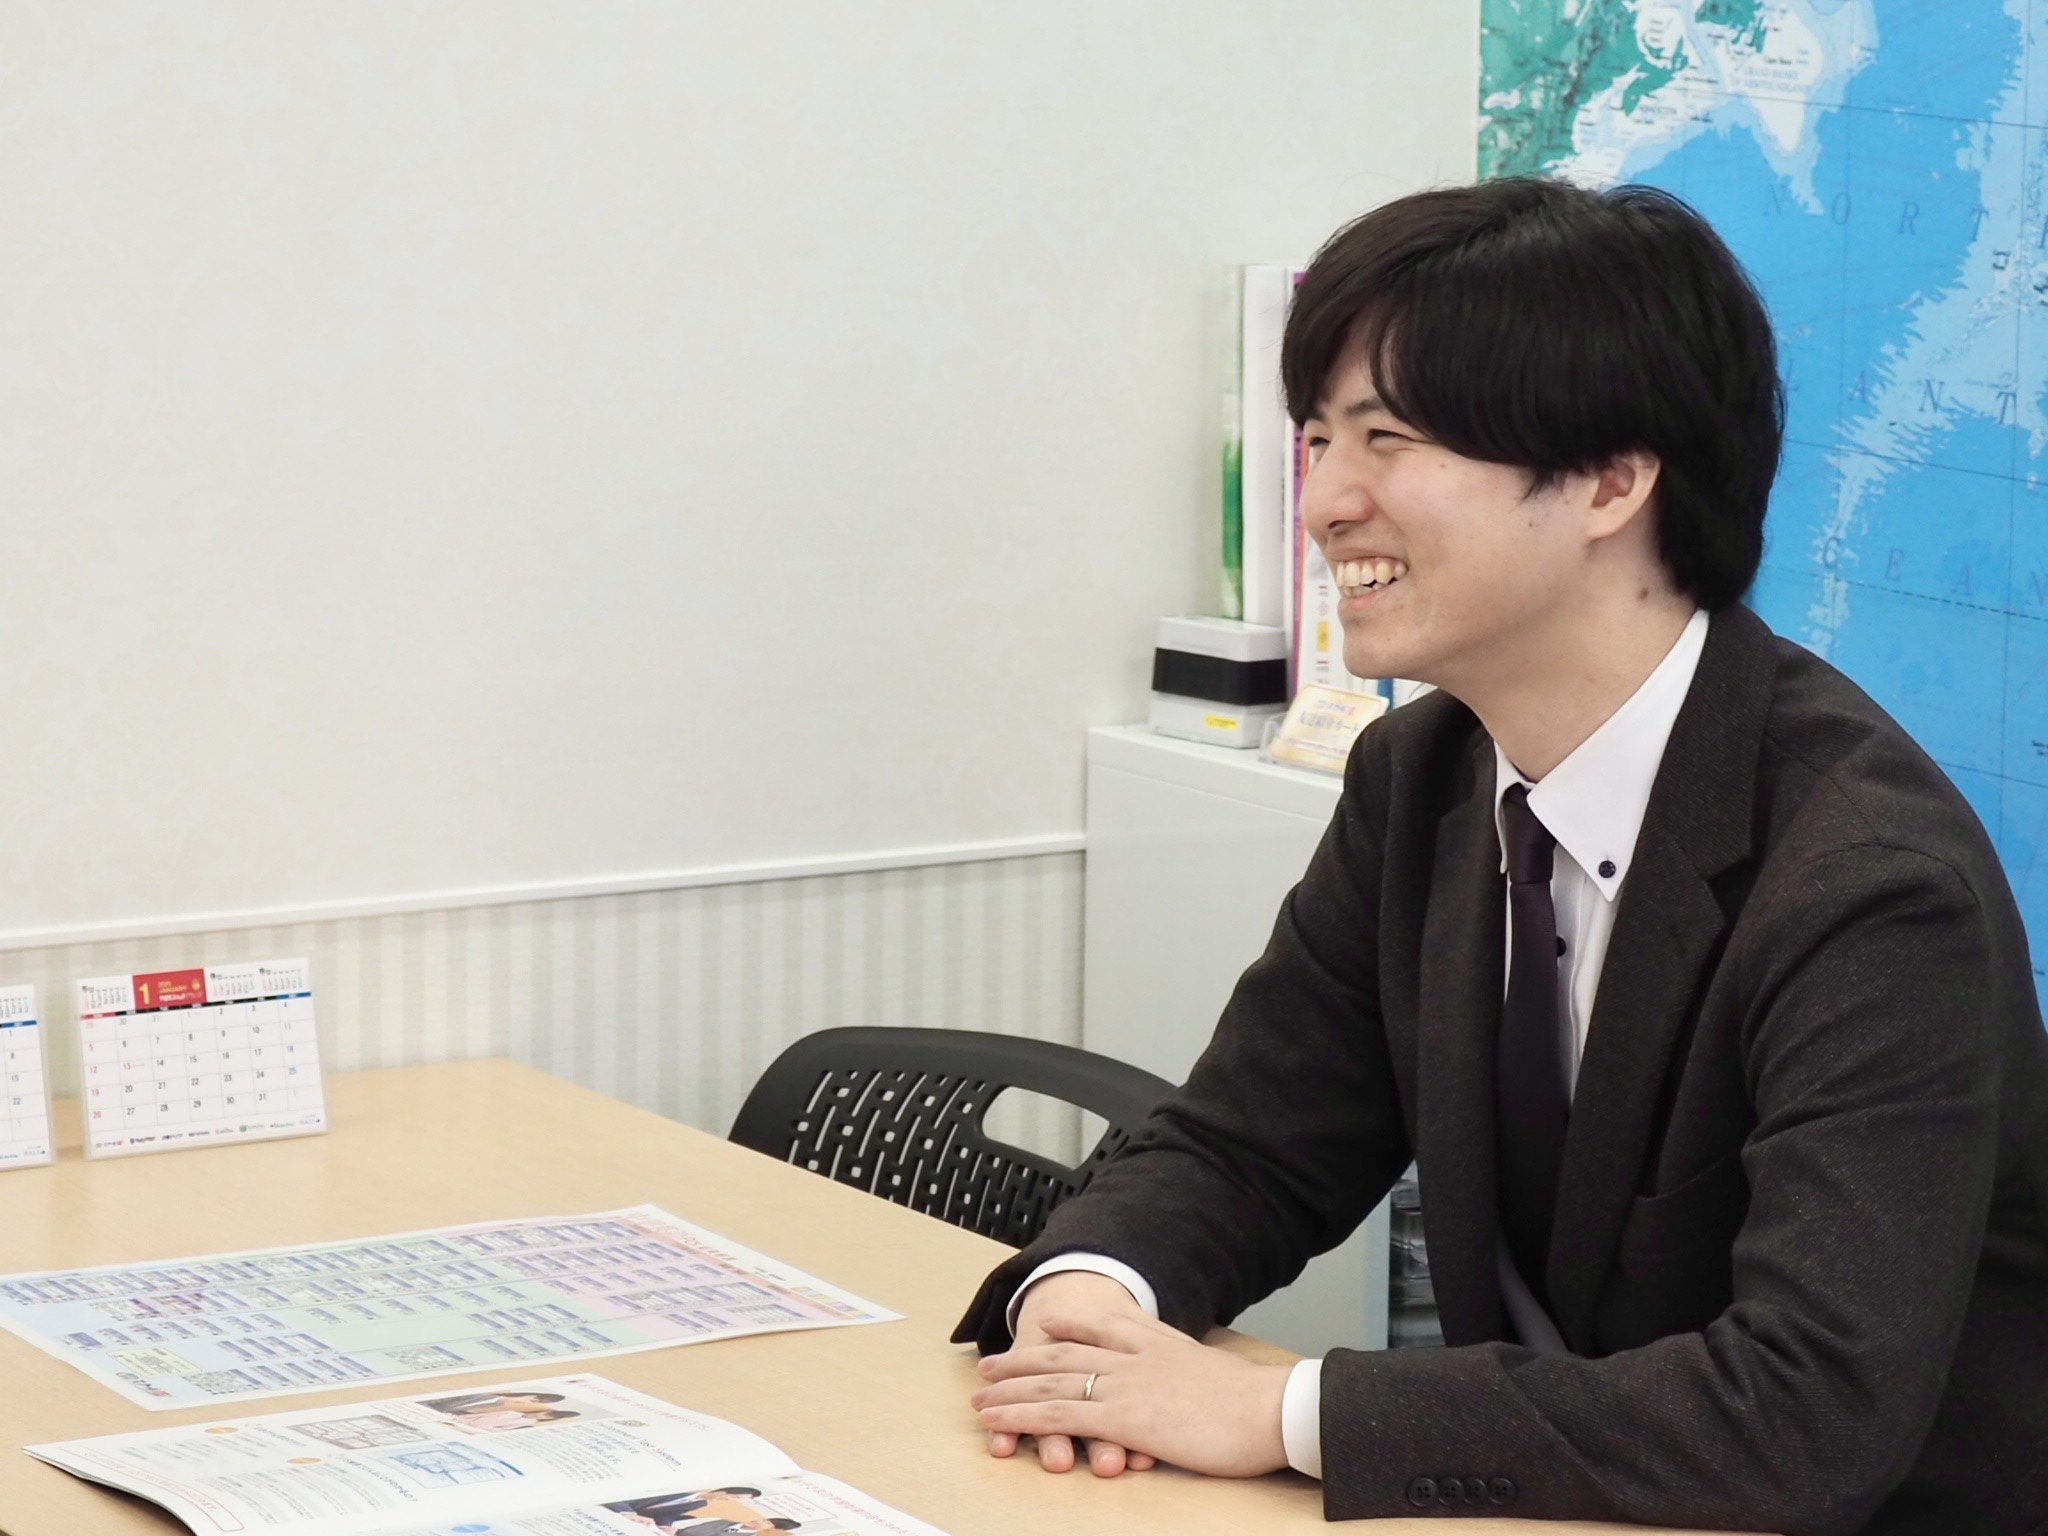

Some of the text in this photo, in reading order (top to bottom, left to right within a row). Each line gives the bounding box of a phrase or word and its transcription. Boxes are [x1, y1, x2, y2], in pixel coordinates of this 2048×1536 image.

[139, 983, 151, 1004] 1
[90, 1066, 97, 1074] 12
[222, 1052, 230, 1060] 16
[286, 1045, 294, 1053] 18
[92, 1088, 100, 1096] 19
[125, 1085, 133, 1093] 20
[191, 1078, 199, 1086] 22
[93, 1111, 101, 1119] 26
[127, 1108, 135, 1116] 27
[160, 1104, 168, 1112] 28
[259, 1093, 266, 1101] 31
